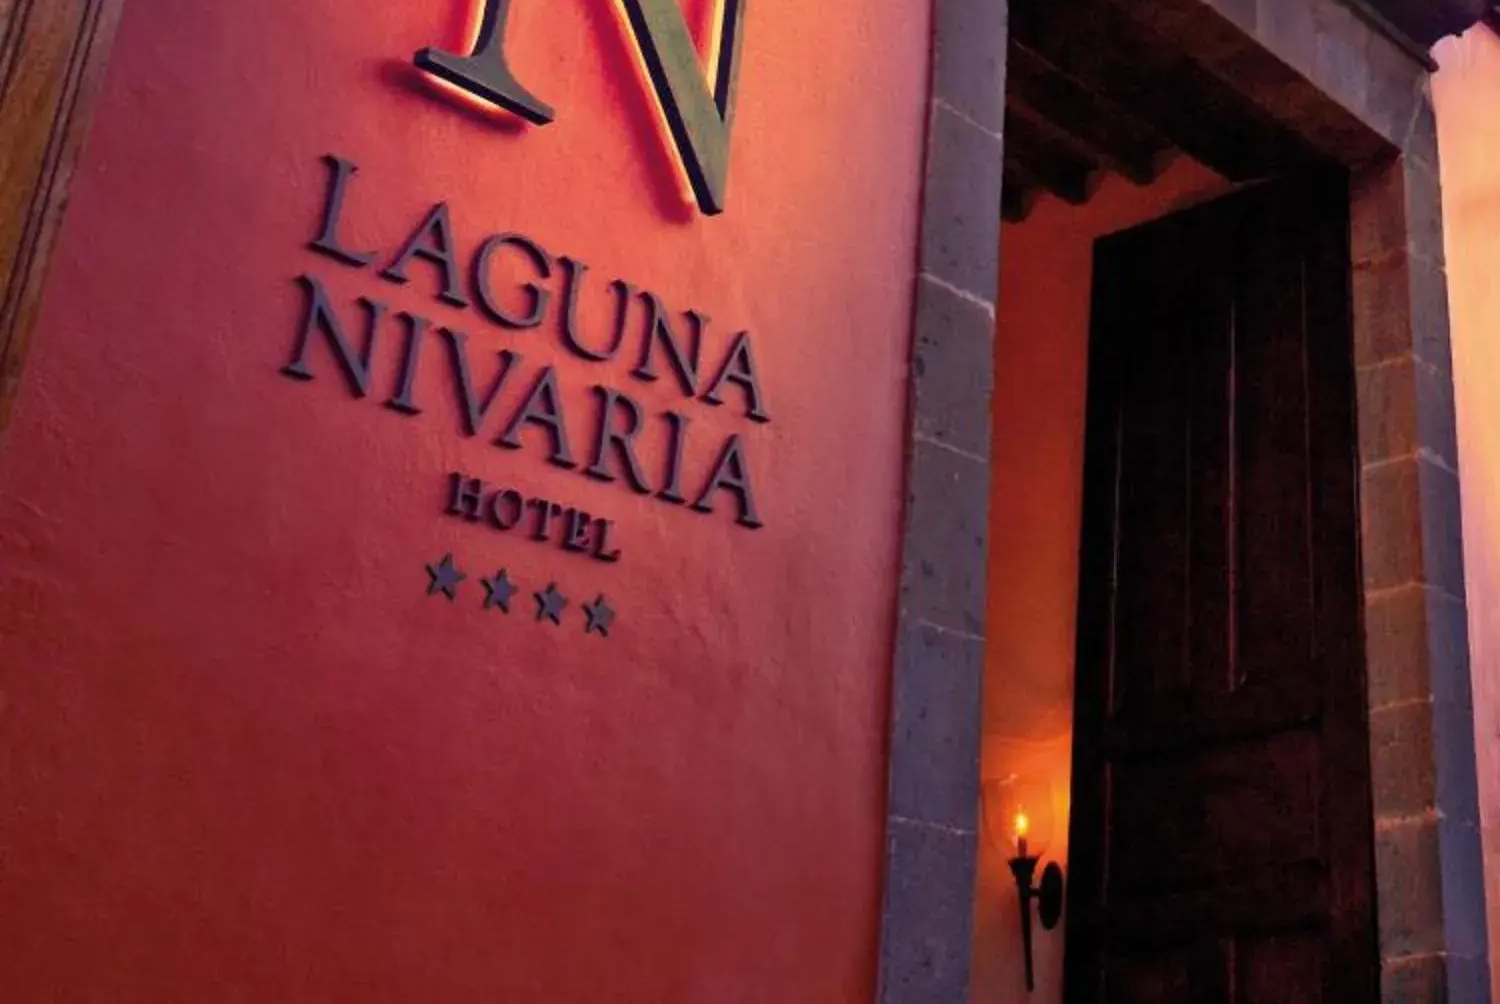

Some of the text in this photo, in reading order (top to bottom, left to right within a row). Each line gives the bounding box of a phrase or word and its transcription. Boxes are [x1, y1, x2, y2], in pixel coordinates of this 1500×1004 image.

[280, 273, 763, 529] NIVARIA
[306, 153, 771, 424] LAGUNA
[445, 471, 621, 562] HOTEL
